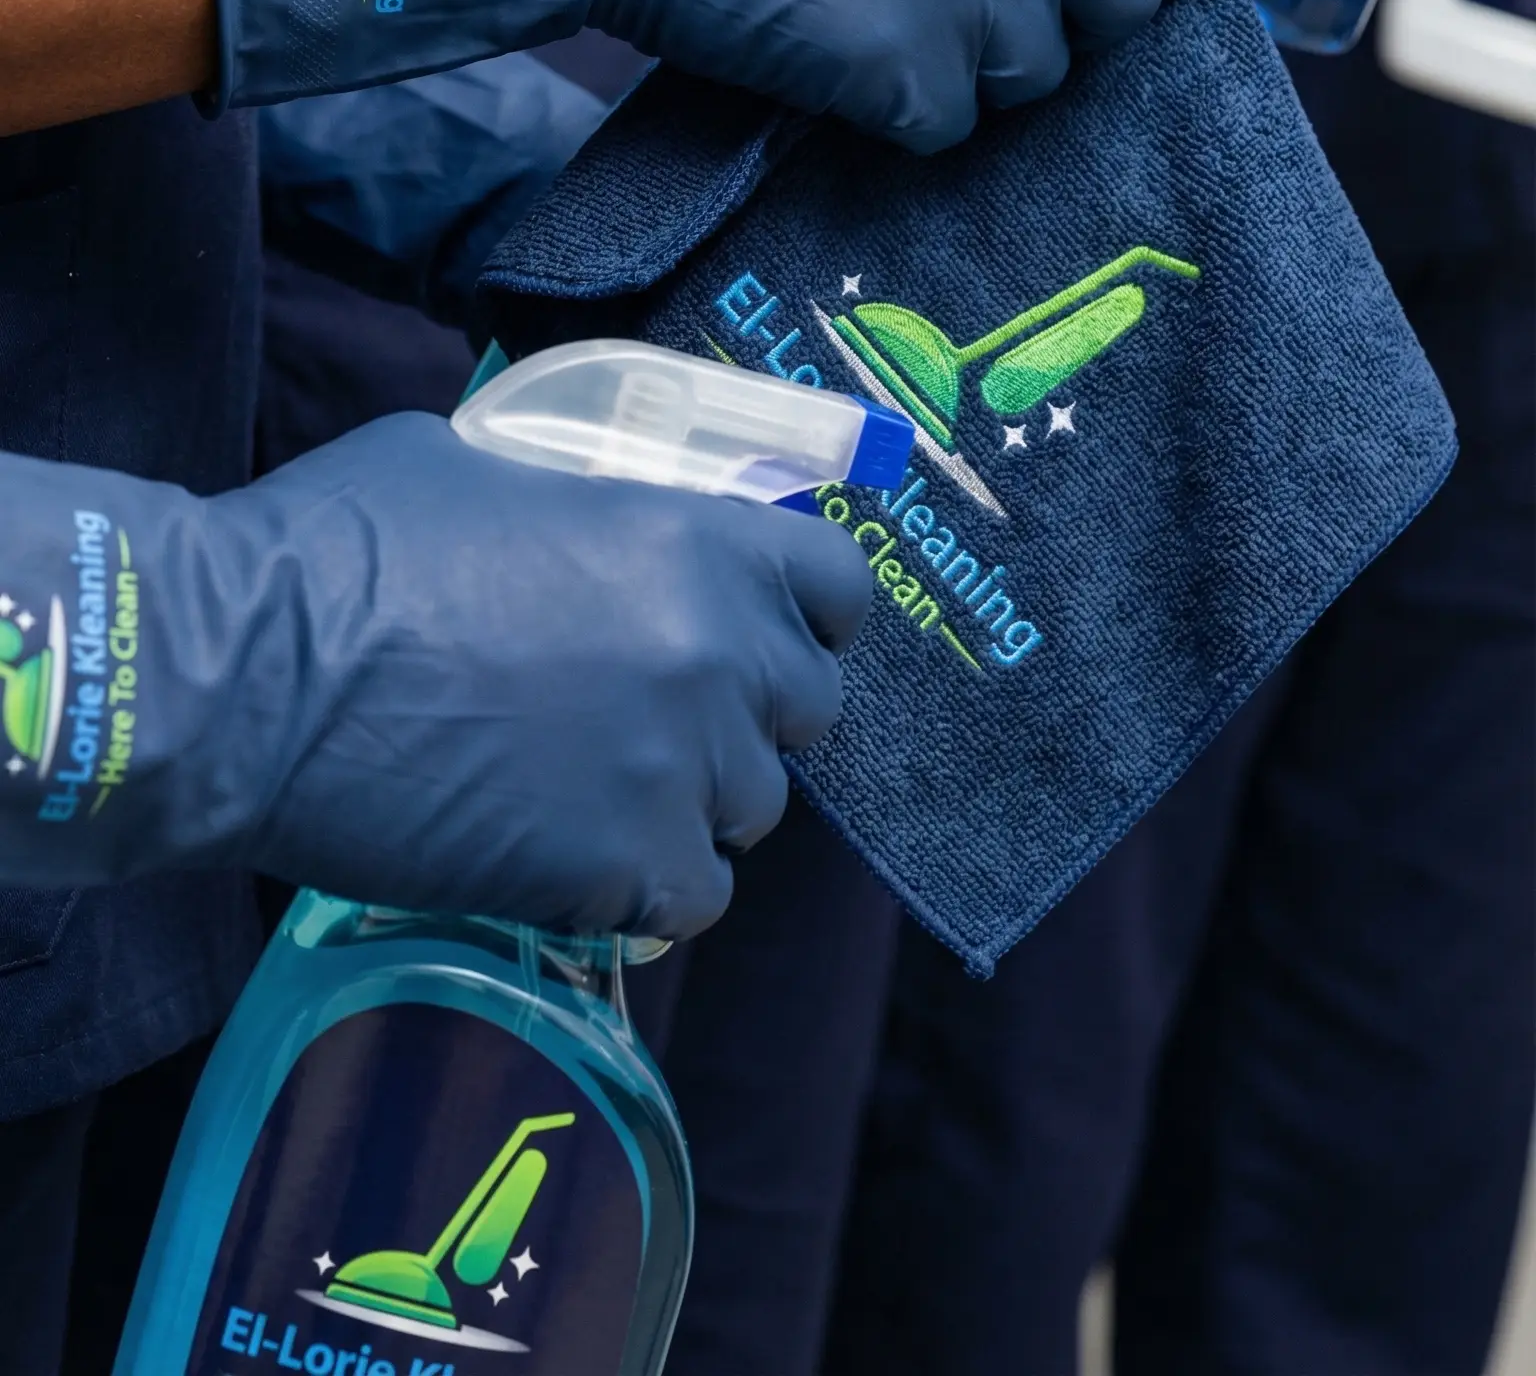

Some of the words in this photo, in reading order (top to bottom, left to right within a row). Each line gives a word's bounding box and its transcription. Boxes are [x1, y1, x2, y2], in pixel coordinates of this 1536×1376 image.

[715, 271, 823, 389] El-Lo
[70, 509, 111, 675] Kleaning
[109, 571, 139, 661] Clean
[853, 521, 941, 631] Clean
[108, 665, 138, 706] To
[38, 680, 106, 821] El-Lorie
[97, 709, 137, 784] Here
